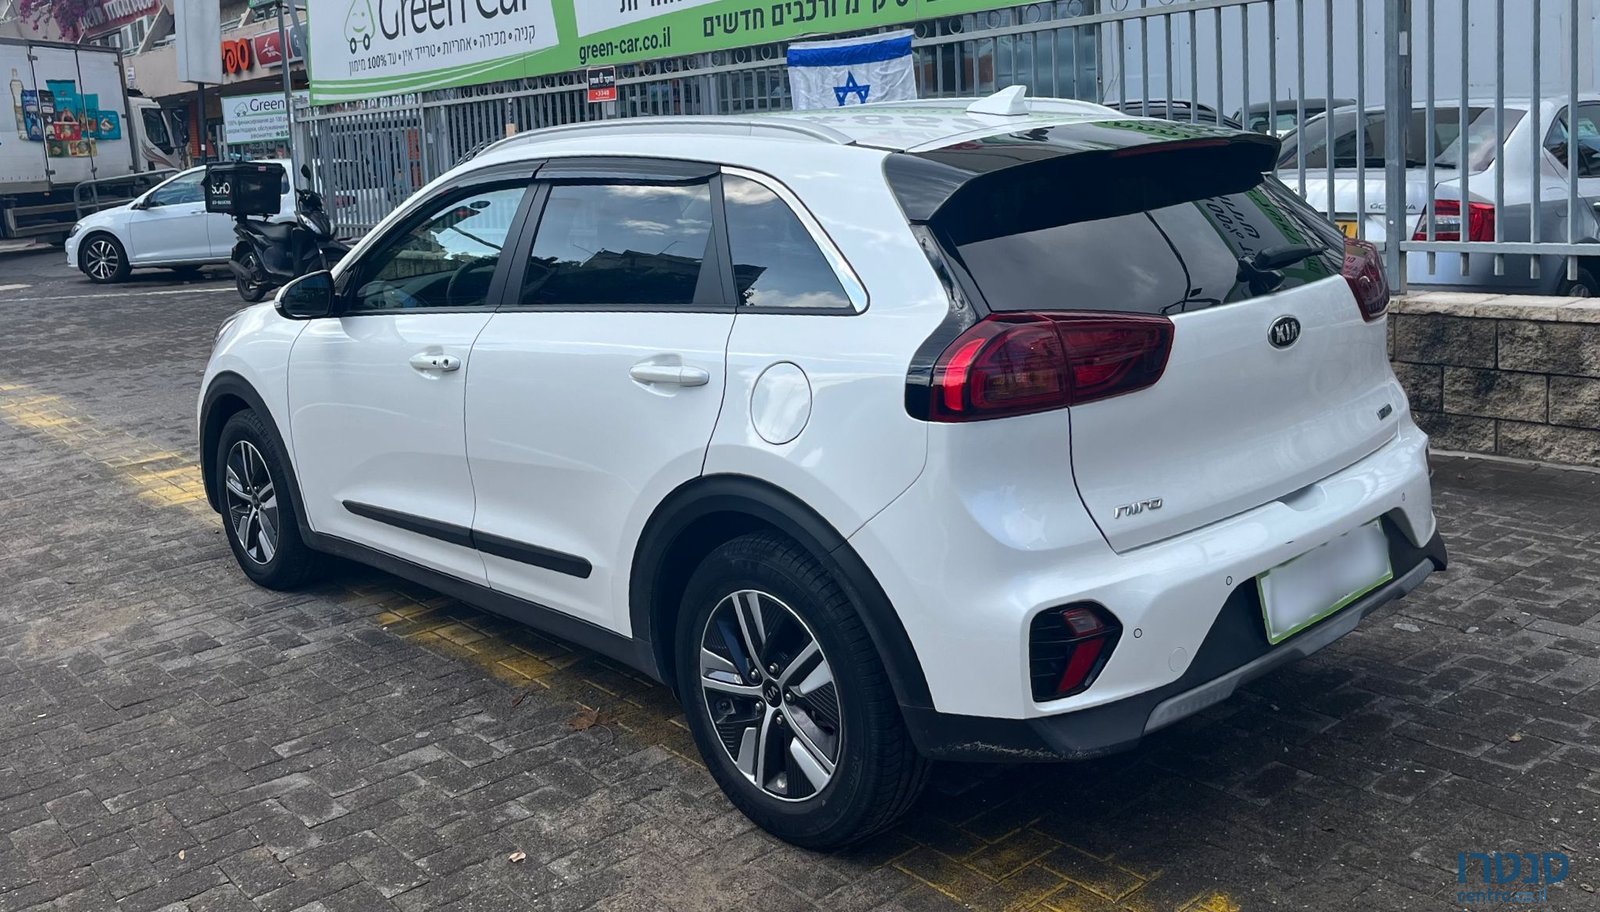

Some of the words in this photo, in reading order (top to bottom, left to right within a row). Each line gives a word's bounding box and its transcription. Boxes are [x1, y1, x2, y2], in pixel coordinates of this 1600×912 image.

[703, 8, 764, 37] חדשים
[480, 31, 506, 48] מכירה
[514, 25, 535, 44] קניה
[415, 44, 436, 59] טרייד
[443, 37, 472, 55] אחריות
[579, 26, 671, 64] green-car.co.il
[368, 55, 387, 69] 100%
[250, 98, 285, 112] Green
[1274, 320, 1298, 344] KIA
